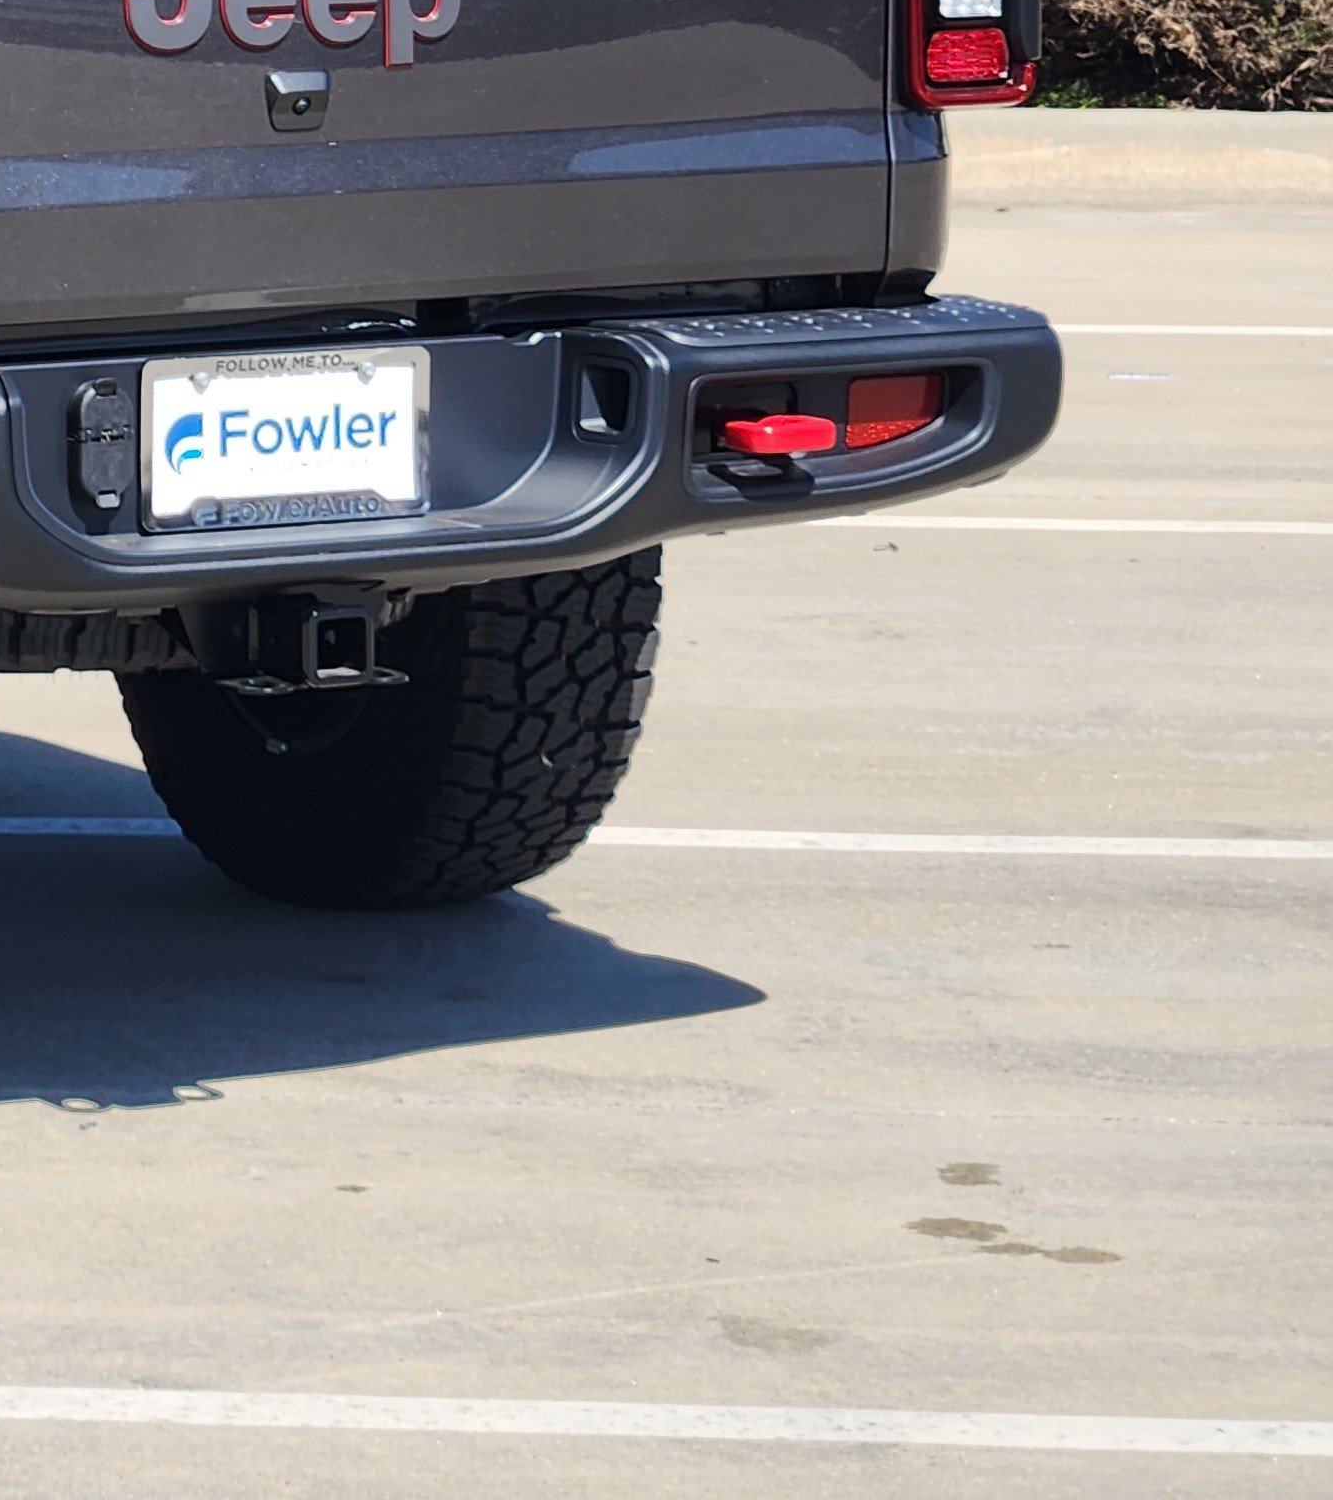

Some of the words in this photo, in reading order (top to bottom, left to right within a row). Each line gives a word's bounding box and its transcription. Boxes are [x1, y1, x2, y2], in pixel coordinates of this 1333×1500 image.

[215, 357, 288, 372] FOLLOW
[292, 355, 315, 368] ME
[218, 403, 398, 457] Fowler
